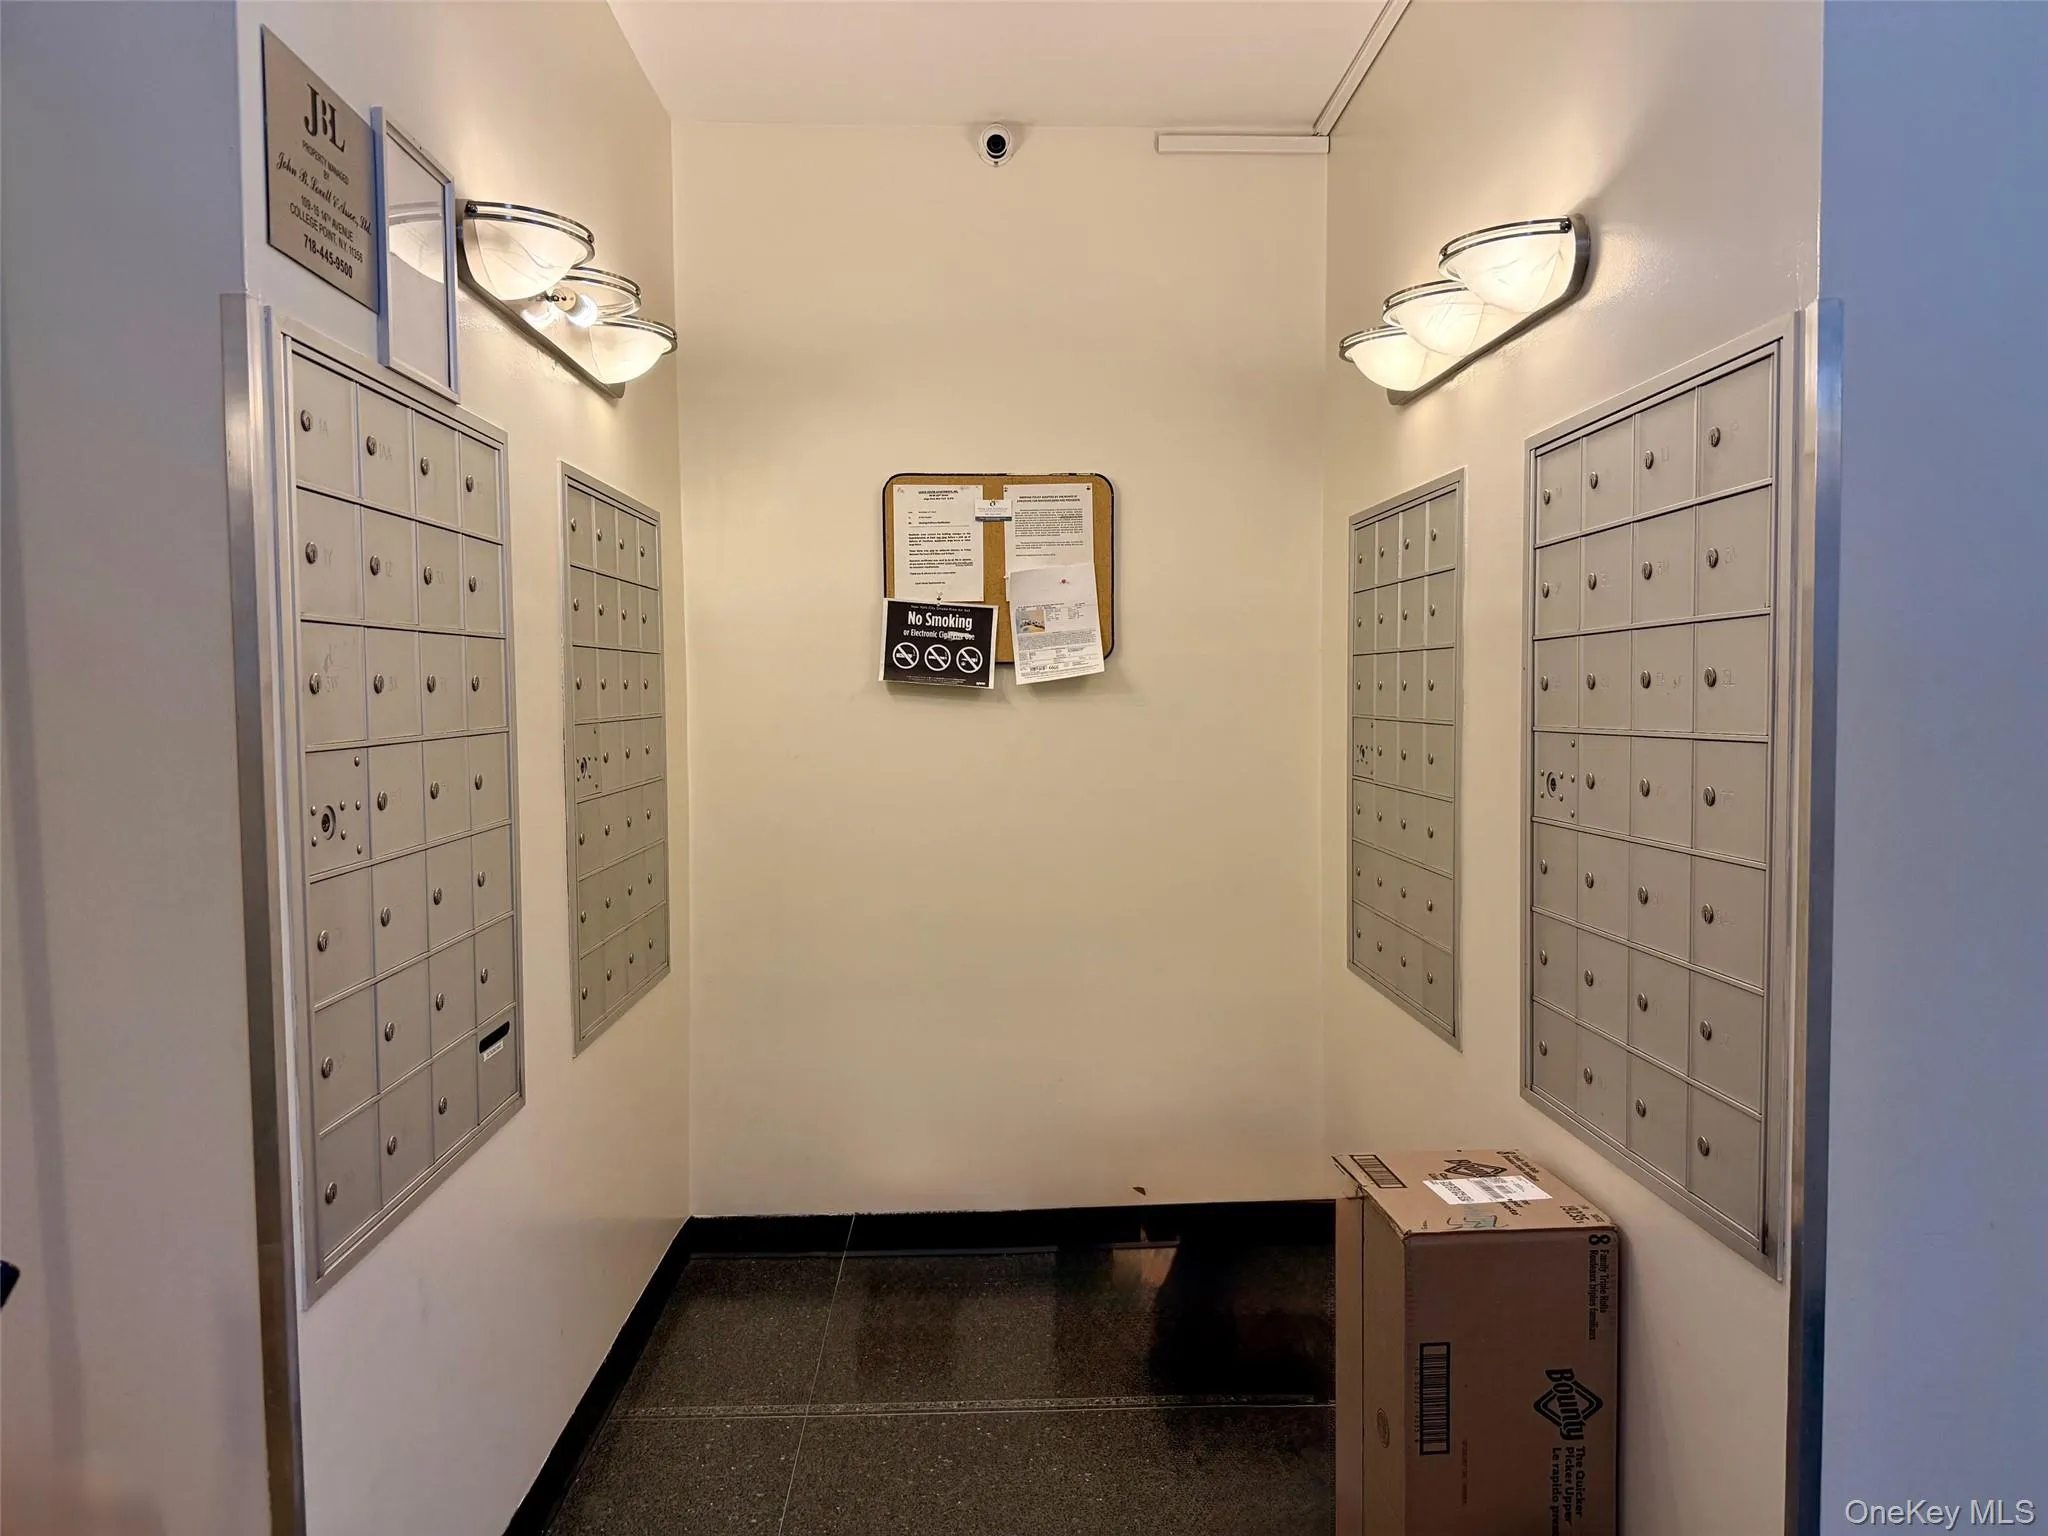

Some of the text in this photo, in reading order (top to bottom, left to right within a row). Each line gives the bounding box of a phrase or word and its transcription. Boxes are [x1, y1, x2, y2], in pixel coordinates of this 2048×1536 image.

[276, 151, 297, 177] John
[289, 202, 319, 232] COLLEGE
[331, 218, 354, 243] AVENUE
[303, 233, 353, 279] 718-445-9500
[908, 610, 973, 631] No Smoking
[911, 628, 938, 639] Electronic
[1588, 1234, 1611, 1246] 8
[1598, 1248, 1609, 1273] Family
[1598, 1273, 1609, 1294] Triple
[1545, 1368, 1585, 1441] Bounty
[1551, 1447, 1562, 1461] Le
[1550, 1463, 1562, 1503] rapido
[1562, 1446, 1575, 1526] Picker Upper
[1575, 1445, 1586, 1518] The Quicker
